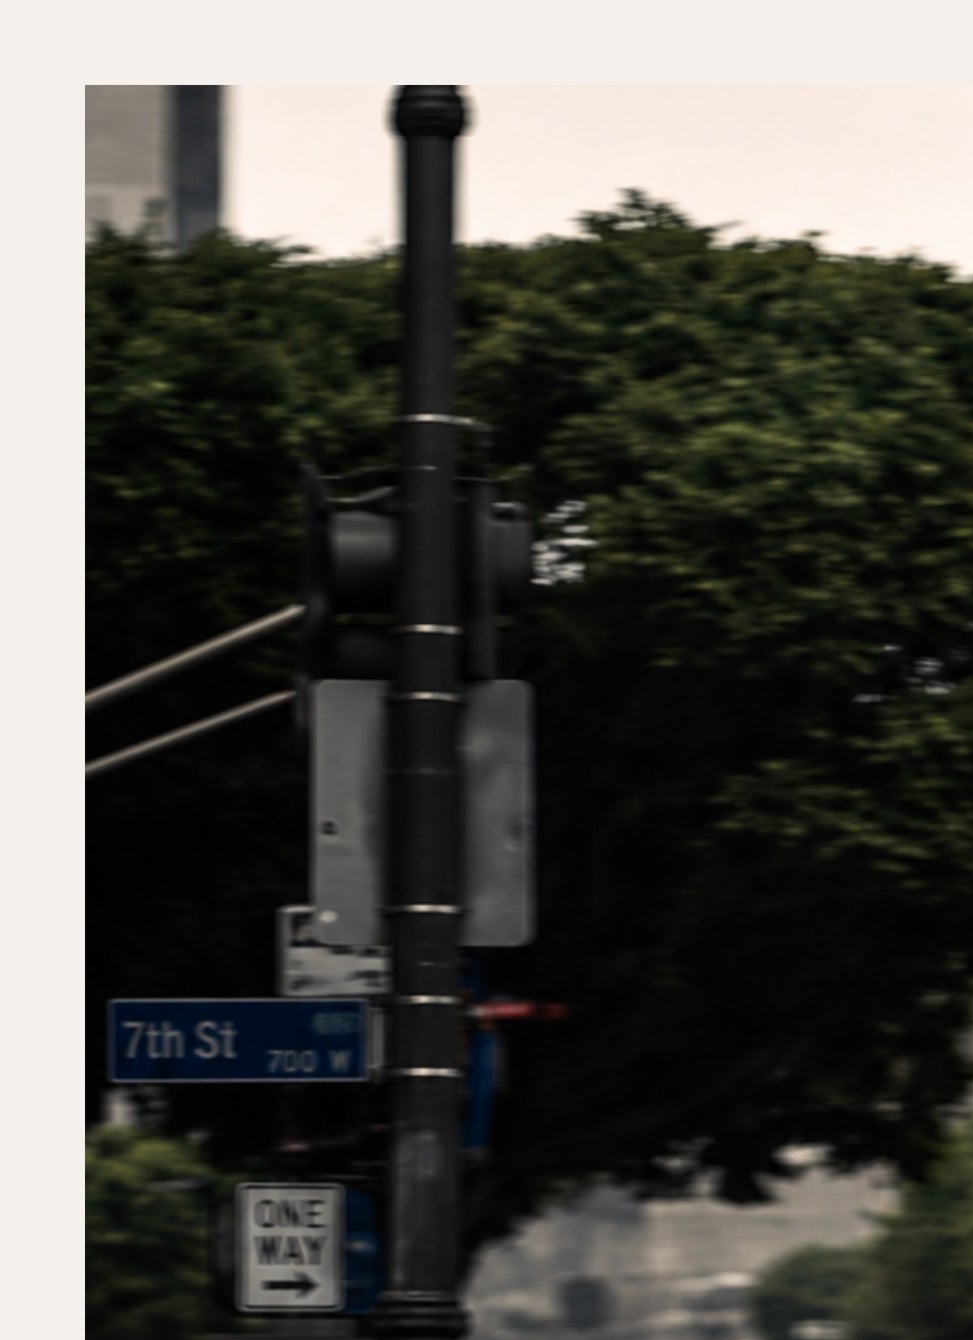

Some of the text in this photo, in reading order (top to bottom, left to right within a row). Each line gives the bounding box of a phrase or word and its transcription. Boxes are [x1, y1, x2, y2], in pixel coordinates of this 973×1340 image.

[121, 1020, 238, 1059] 7th St
[266, 1049, 353, 1074] 700 W
[254, 1199, 326, 1229] ONE
[253, 1236, 328, 1266] WAY
